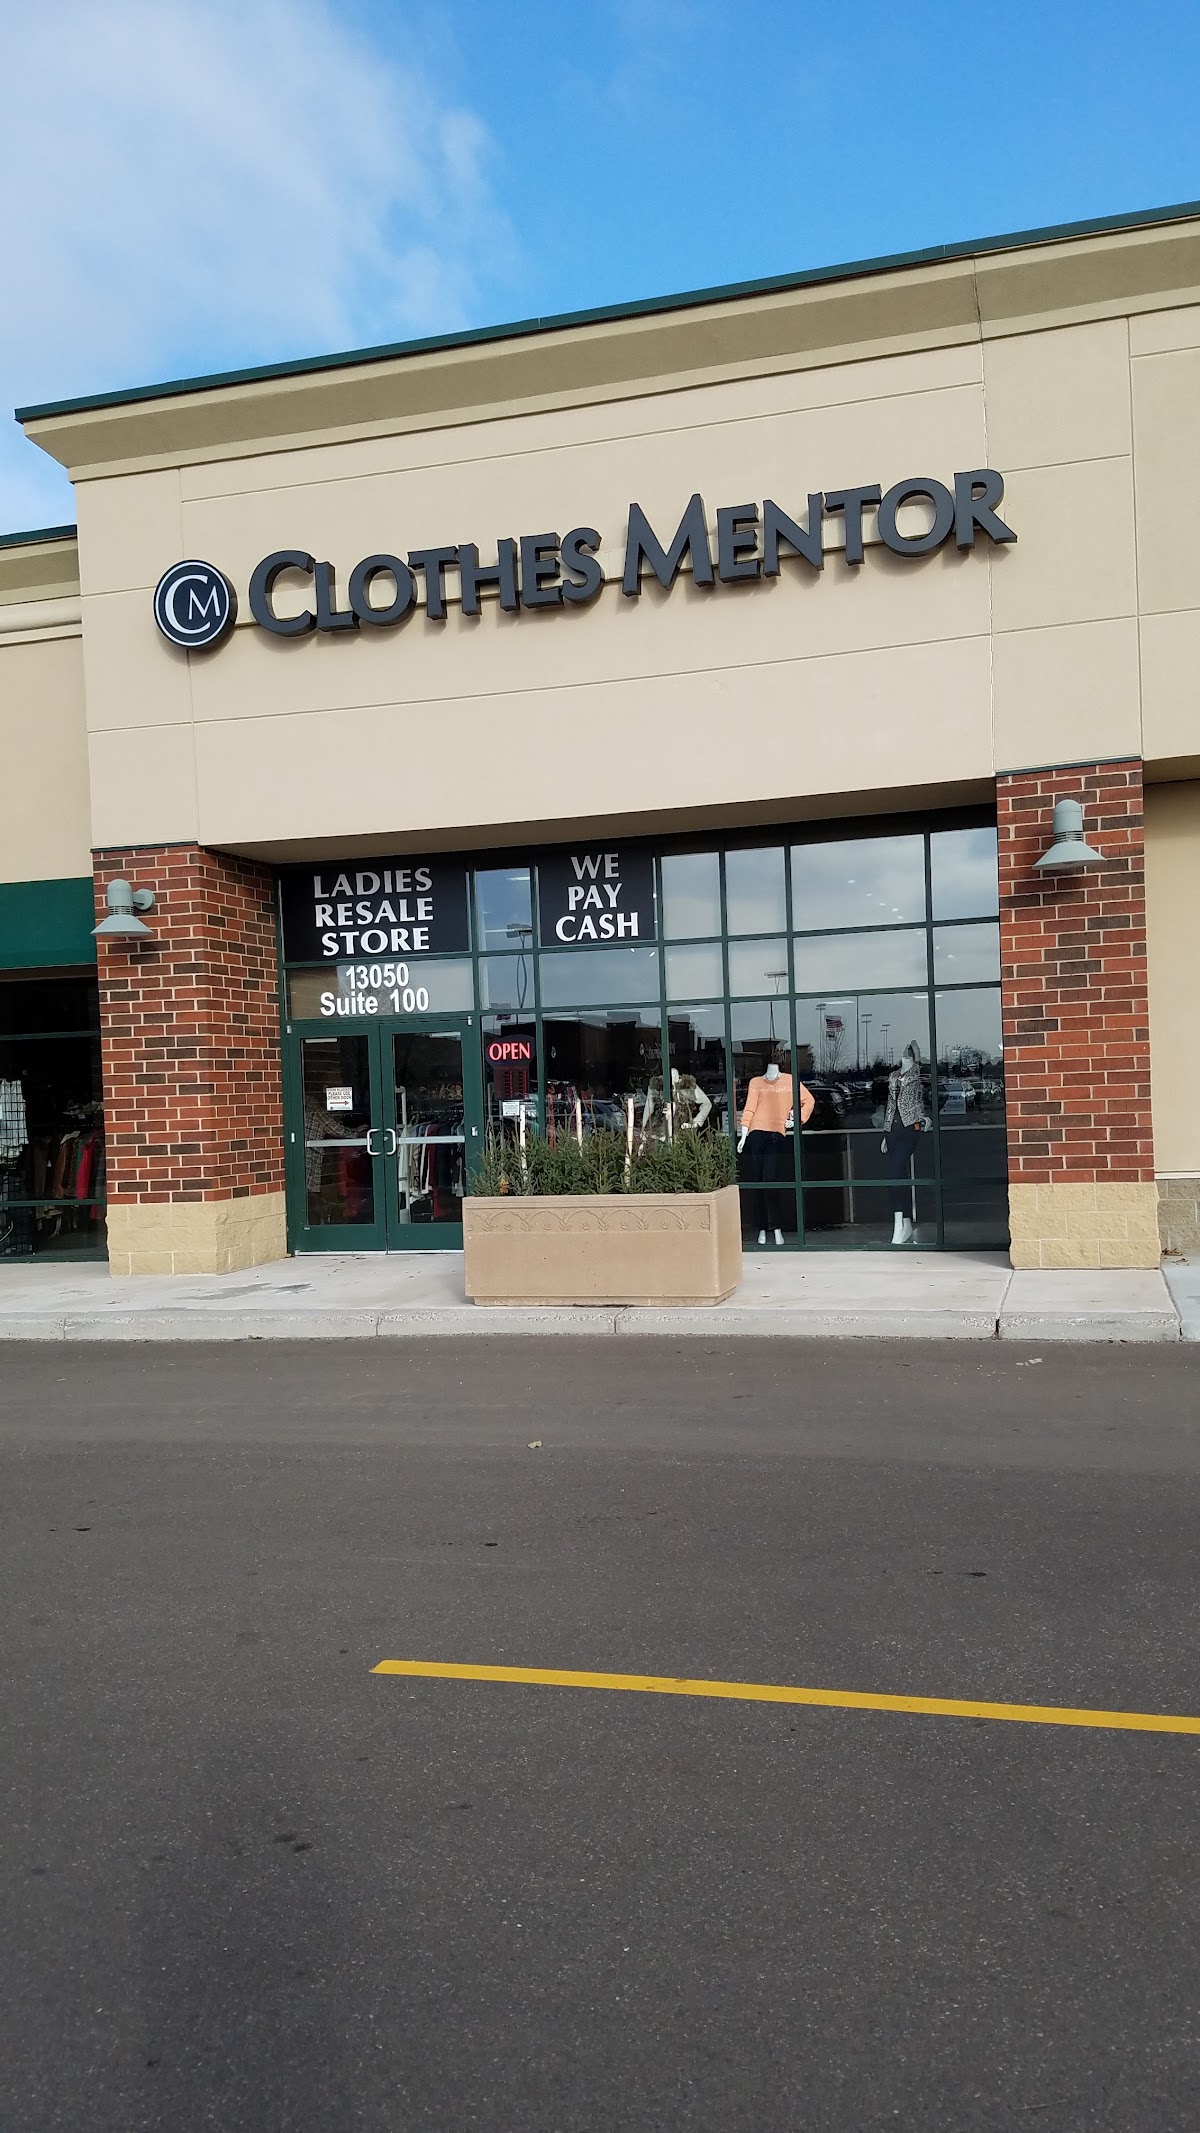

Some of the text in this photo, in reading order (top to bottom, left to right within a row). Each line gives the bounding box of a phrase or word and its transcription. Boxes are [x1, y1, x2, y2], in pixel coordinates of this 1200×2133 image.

[248, 468, 1017, 637] CLOTHES MENTOR
[570, 853, 620, 880] WE
[313, 867, 433, 898] LADIES
[568, 883, 623, 911] PAY
[315, 897, 434, 927] RESALE
[321, 927, 430, 956] STORE
[555, 912, 640, 942] CASH
[346, 962, 410, 989] 13050
[320, 987, 429, 1016] Suite 100
[489, 1042, 531, 1060] OPEN
